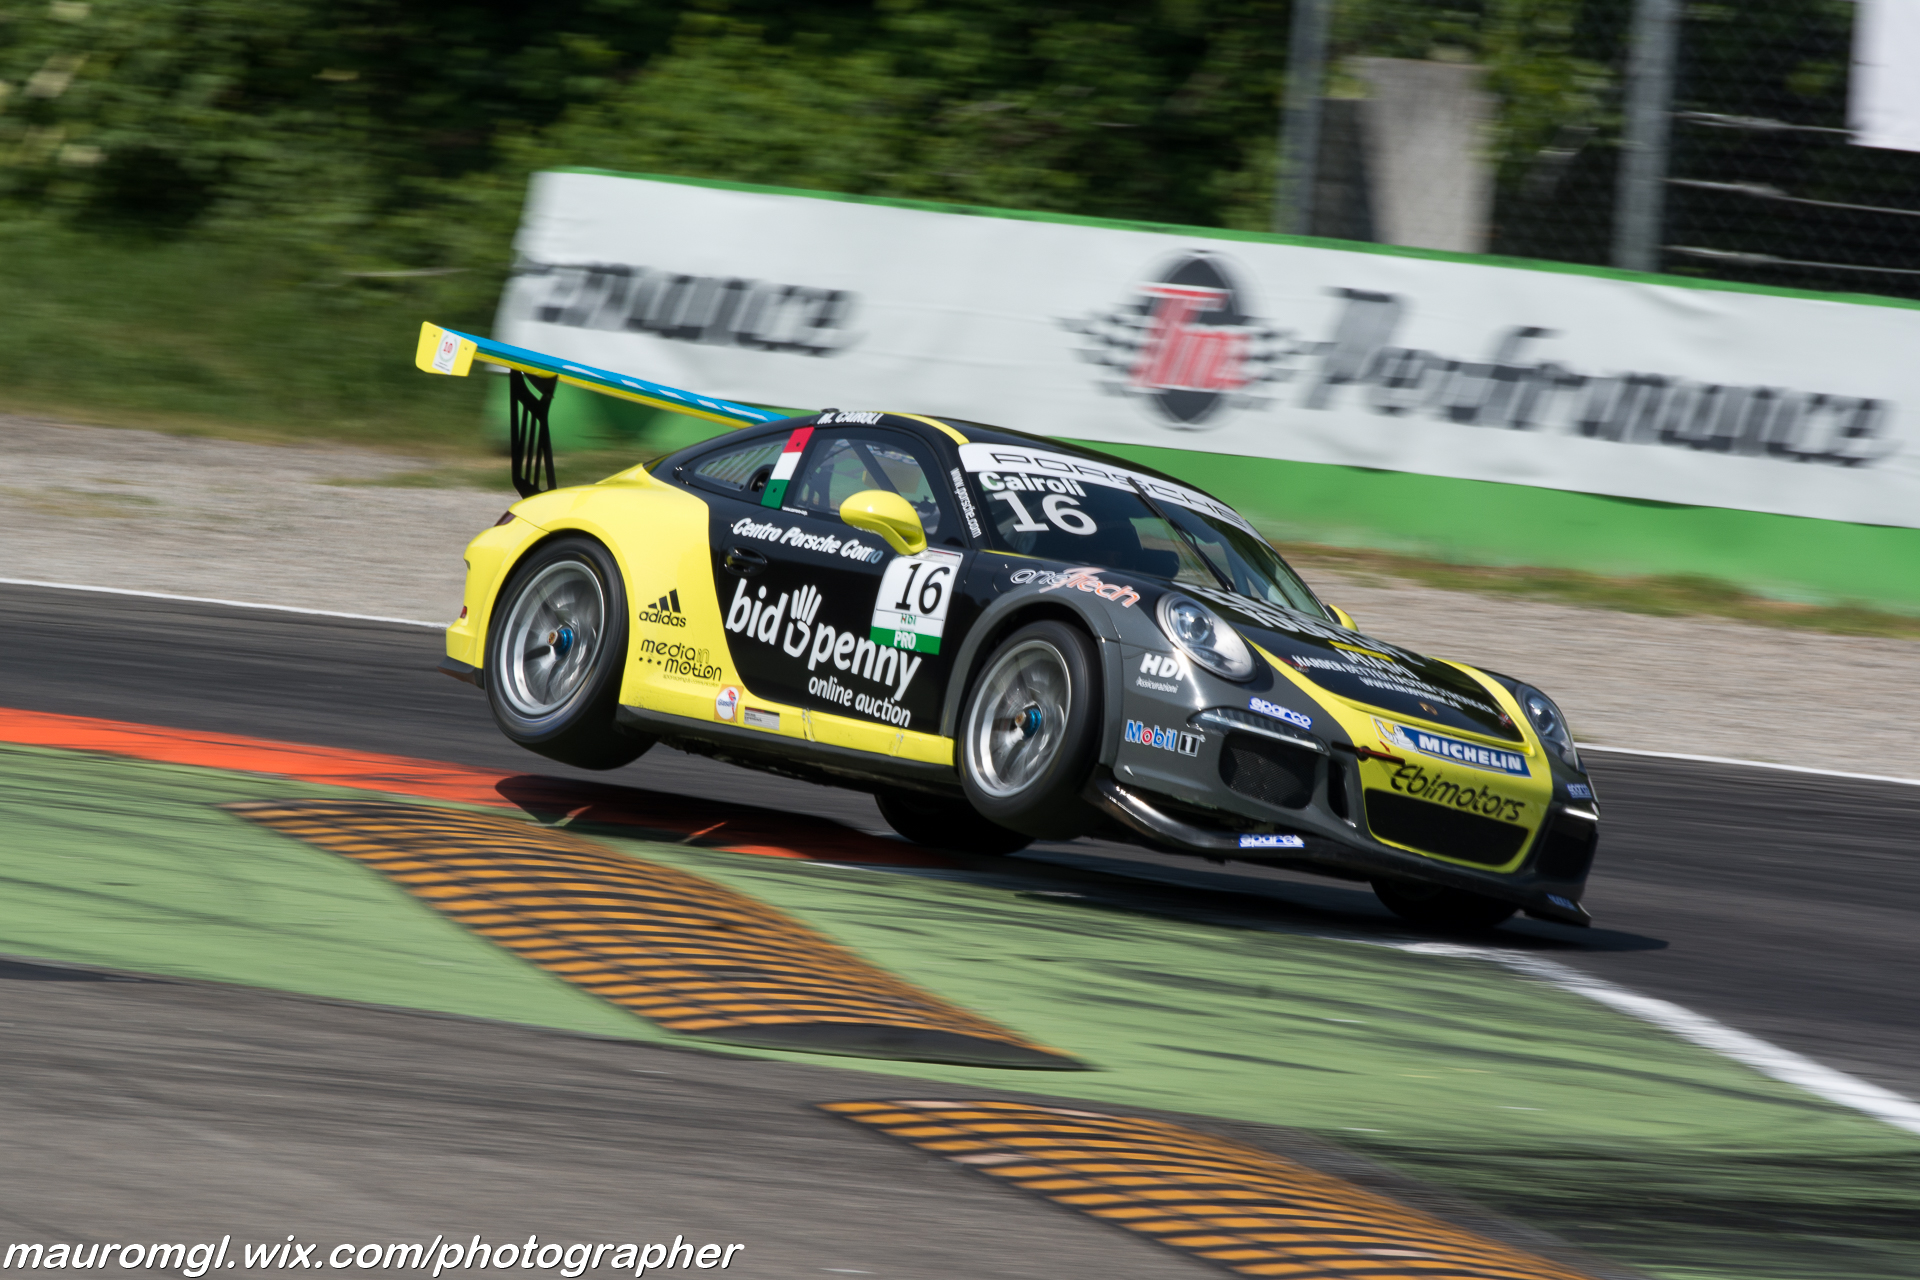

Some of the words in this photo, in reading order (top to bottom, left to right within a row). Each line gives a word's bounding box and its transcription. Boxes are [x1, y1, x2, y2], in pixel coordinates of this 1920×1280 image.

[817, 412, 833, 425] M.
[835, 412, 884, 425] CAIROLI
[979, 471, 1087, 498] Cairoli
[950, 467, 982, 539] www.porsche.com
[993, 491, 1098, 536] 16
[733, 518, 783, 542] Centro
[780, 526, 842, 554] Porsche
[840, 539, 884, 565] Como
[895, 562, 951, 616] 16
[639, 610, 687, 628] adidas
[893, 630, 917, 650] PRO
[665, 657, 722, 682] motion
[807, 622, 922, 702] penny
[1291, 654, 1347, 673] HARDER
[808, 676, 851, 707] online
[855, 692, 912, 728] auction
[1250, 697, 1312, 729] sparco
[1124, 719, 1178, 752] Mobil
[1418, 733, 1523, 771] MICHELIN
[1391, 763, 1526, 822] Ebimotors
